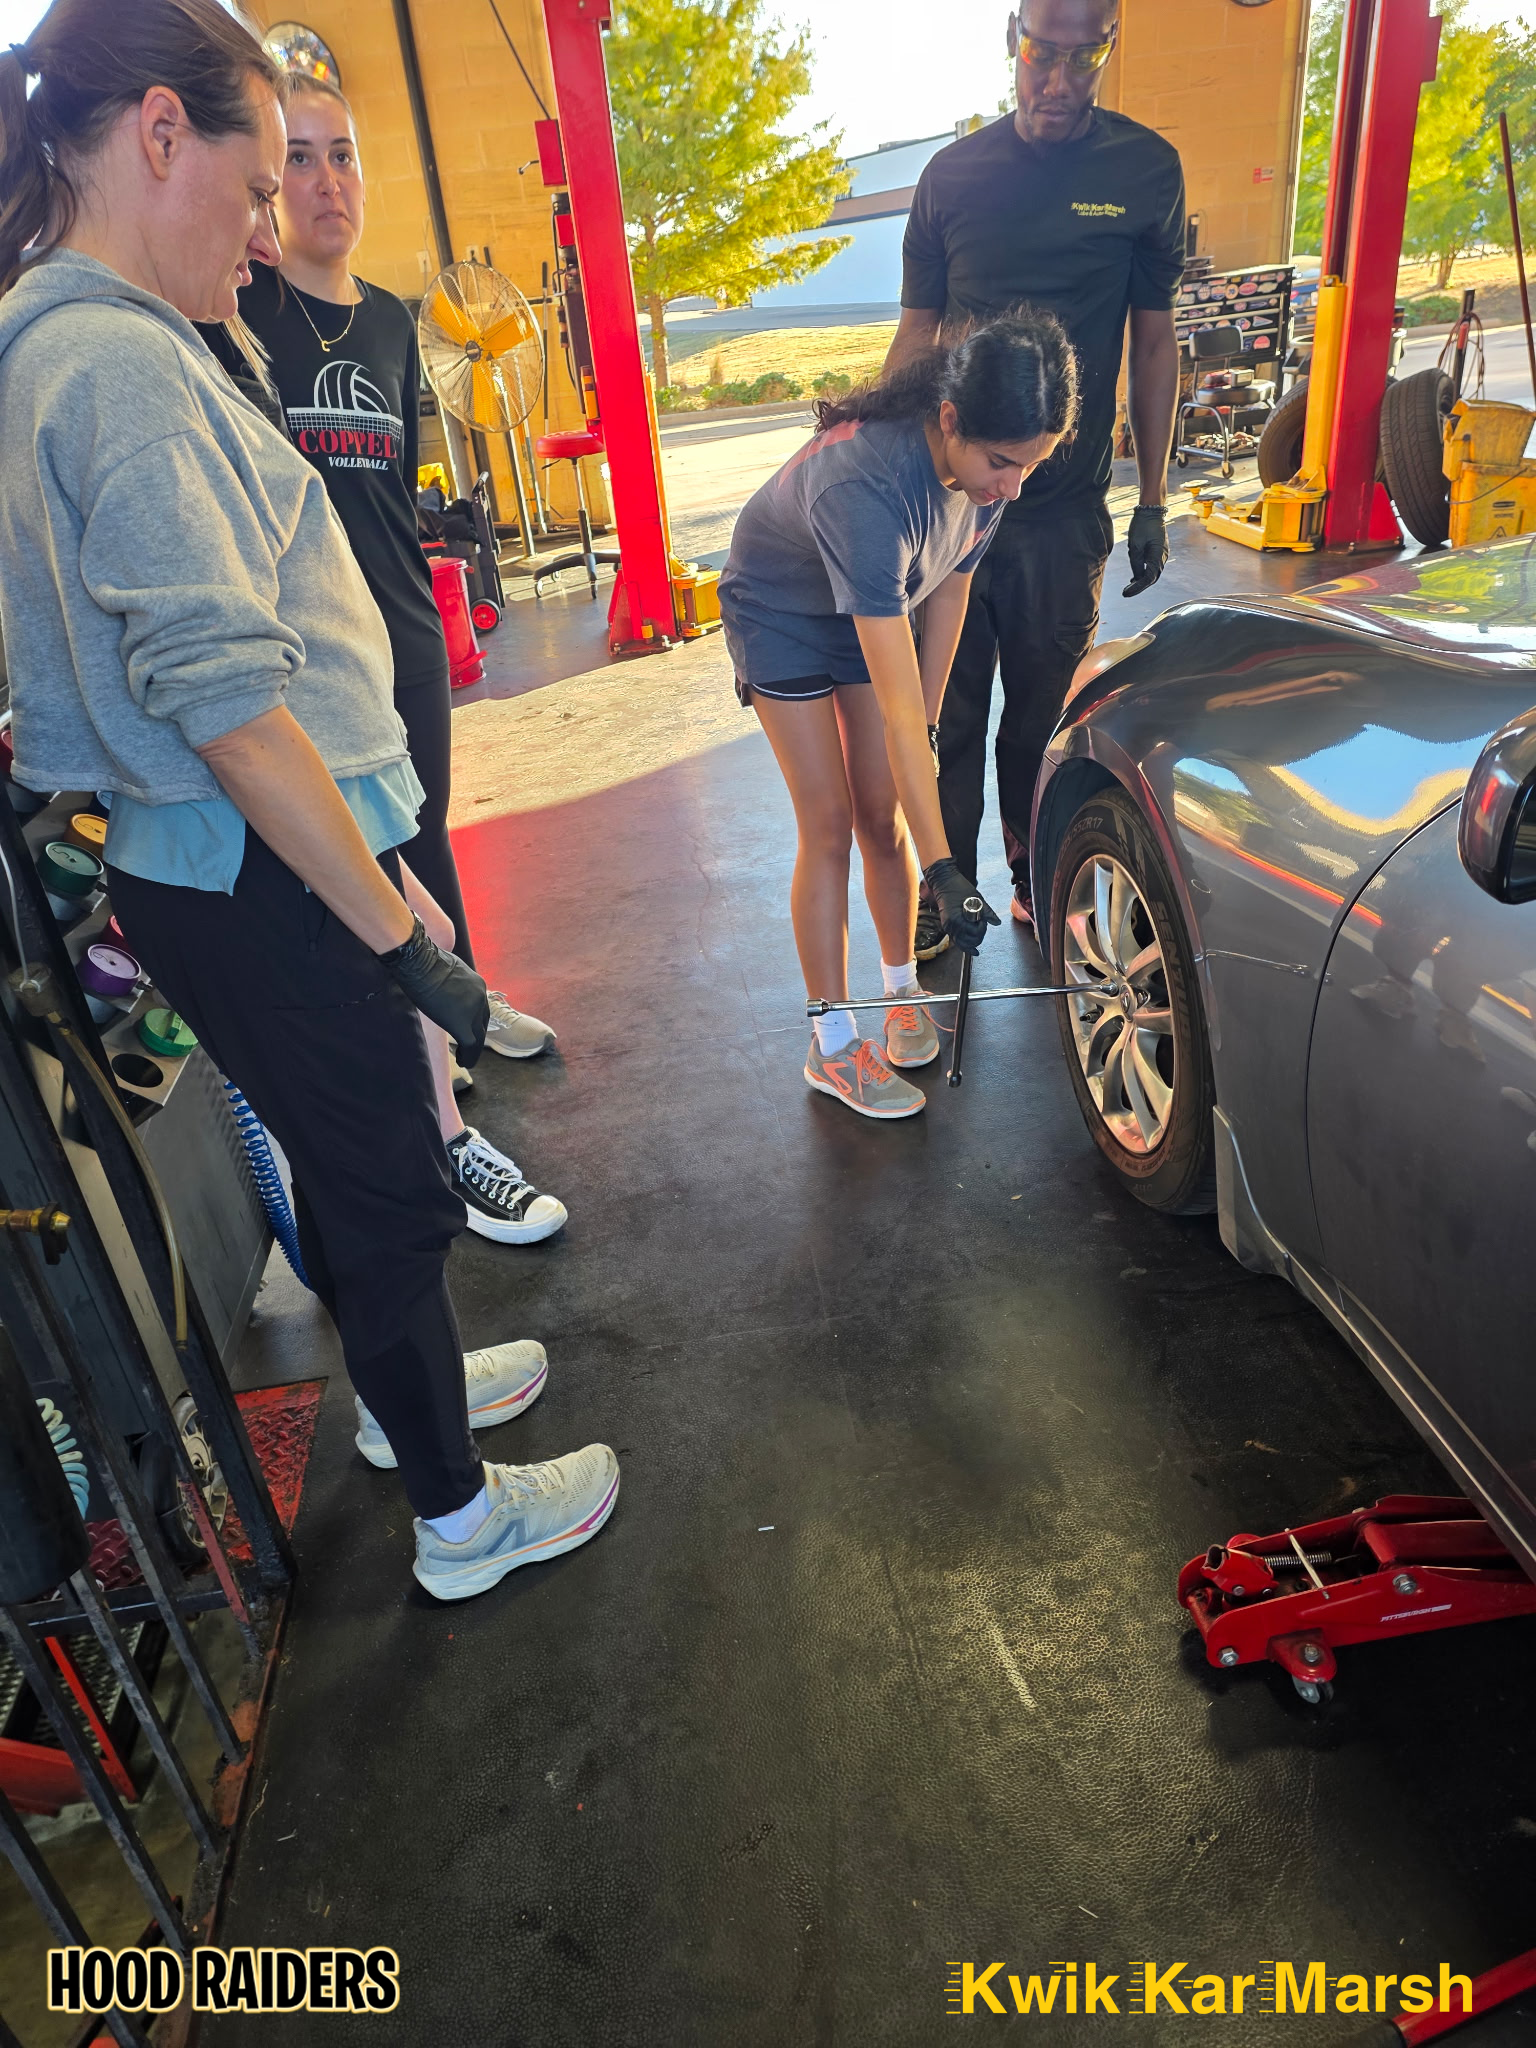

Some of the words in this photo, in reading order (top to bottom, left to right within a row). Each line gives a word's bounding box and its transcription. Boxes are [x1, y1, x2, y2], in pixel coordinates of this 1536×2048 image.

[1071, 202, 1091, 211] Kwik
[1104, 203, 1126, 214] Marsh
[299, 429, 397, 458] COPPEL
